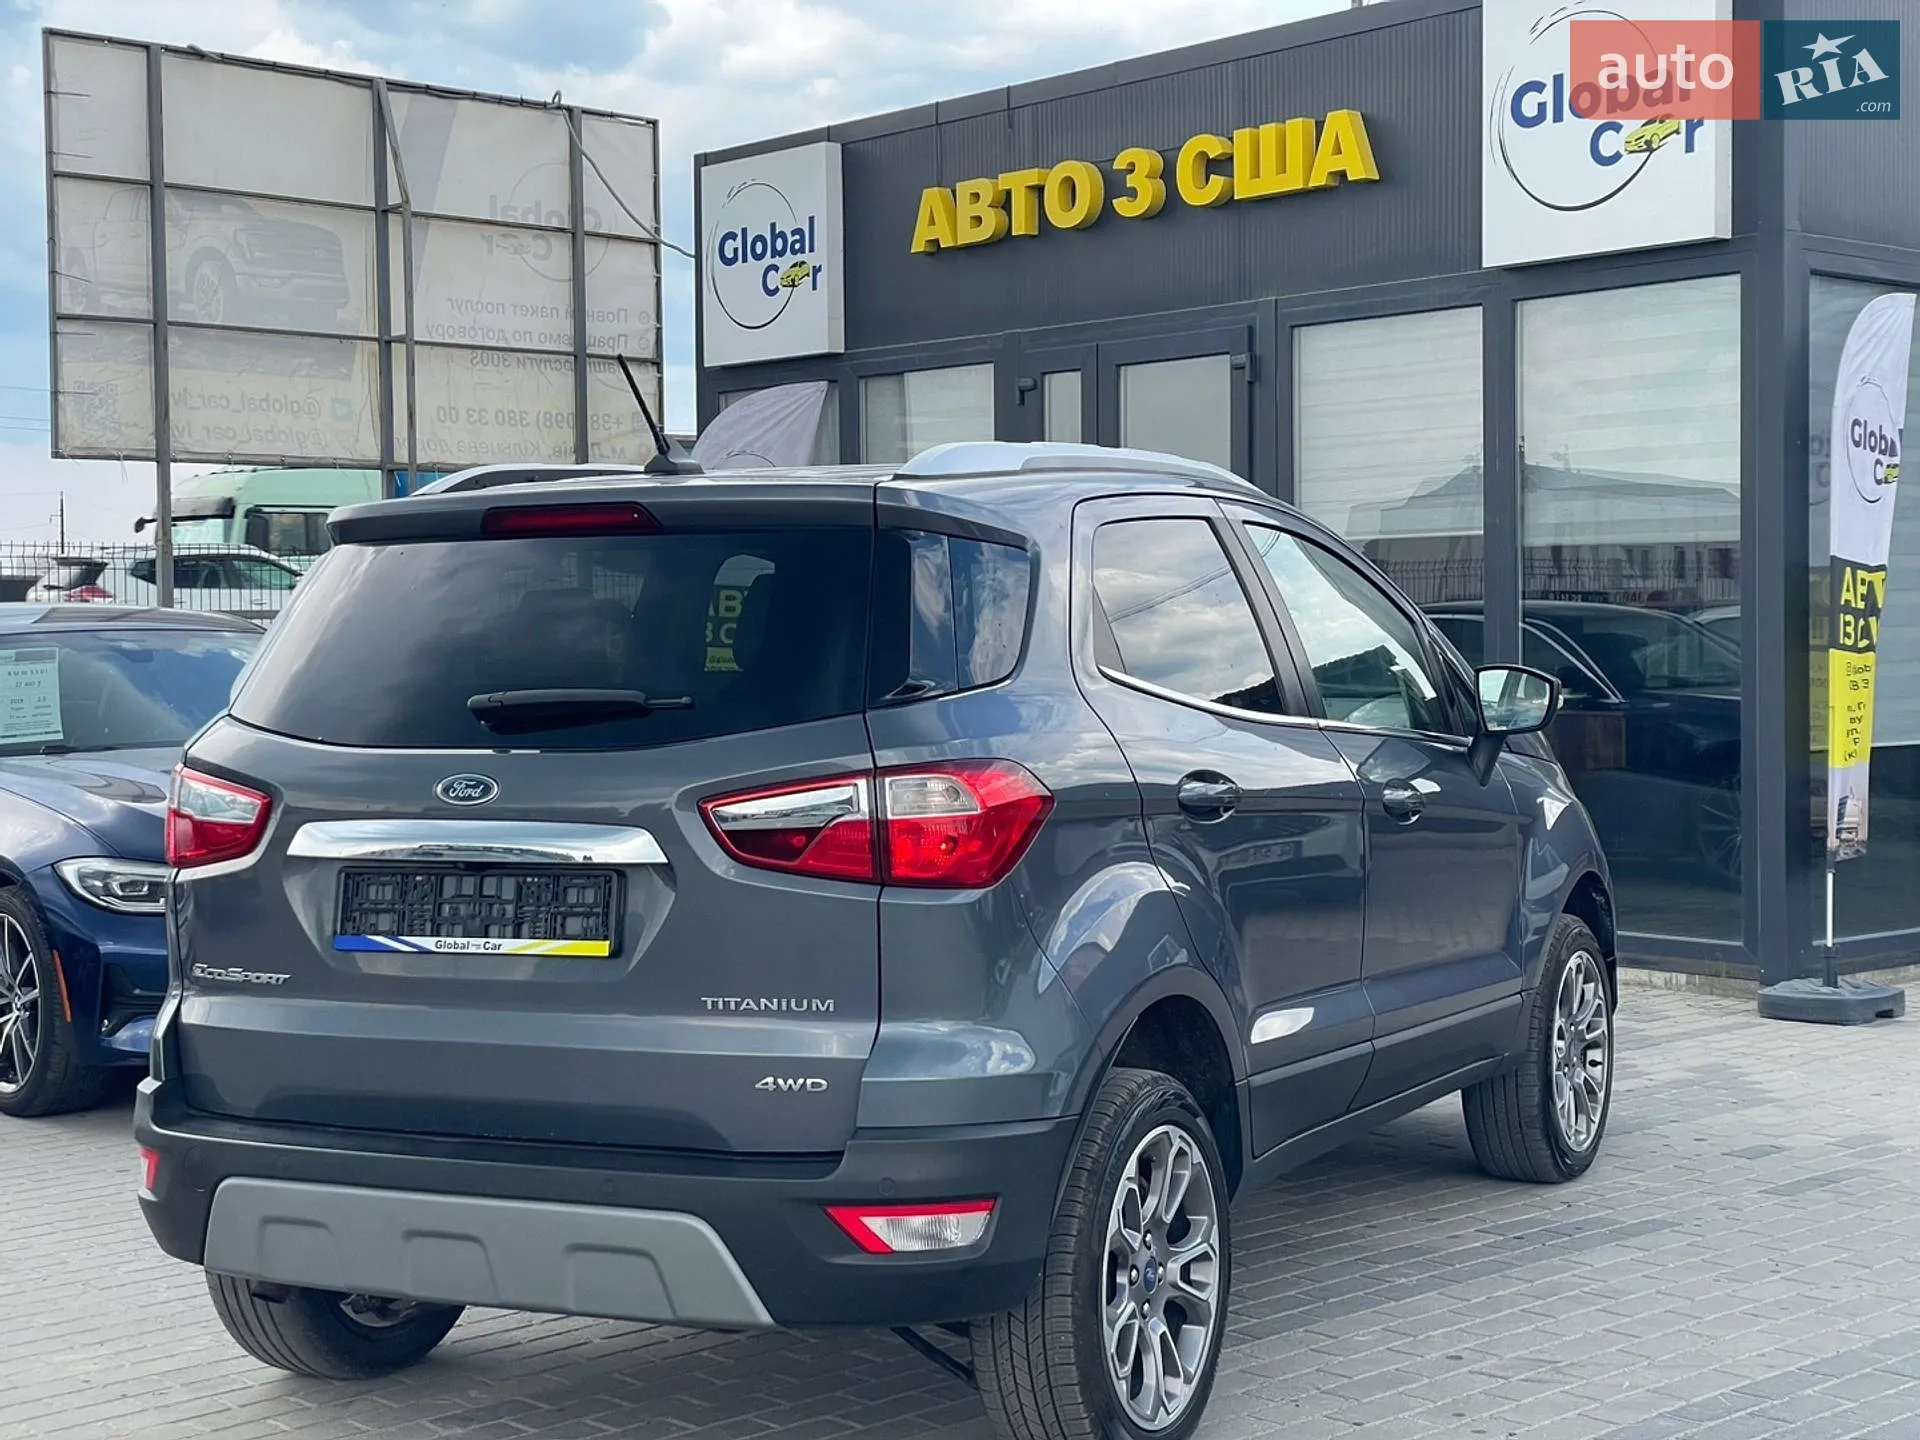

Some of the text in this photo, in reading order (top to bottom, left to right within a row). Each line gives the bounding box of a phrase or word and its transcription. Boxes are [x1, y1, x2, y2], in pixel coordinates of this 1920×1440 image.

[1511, 50, 1692, 128] Global
[910, 158, 1104, 254] АВТО
[1175, 108, 1380, 208] США
[718, 215, 815, 267] Global
[449, 780, 485, 798] Ford
[434, 939, 503, 951] Global Car
[700, 997, 836, 1013] TITANIUM
[754, 1076, 829, 1093] 4WD
